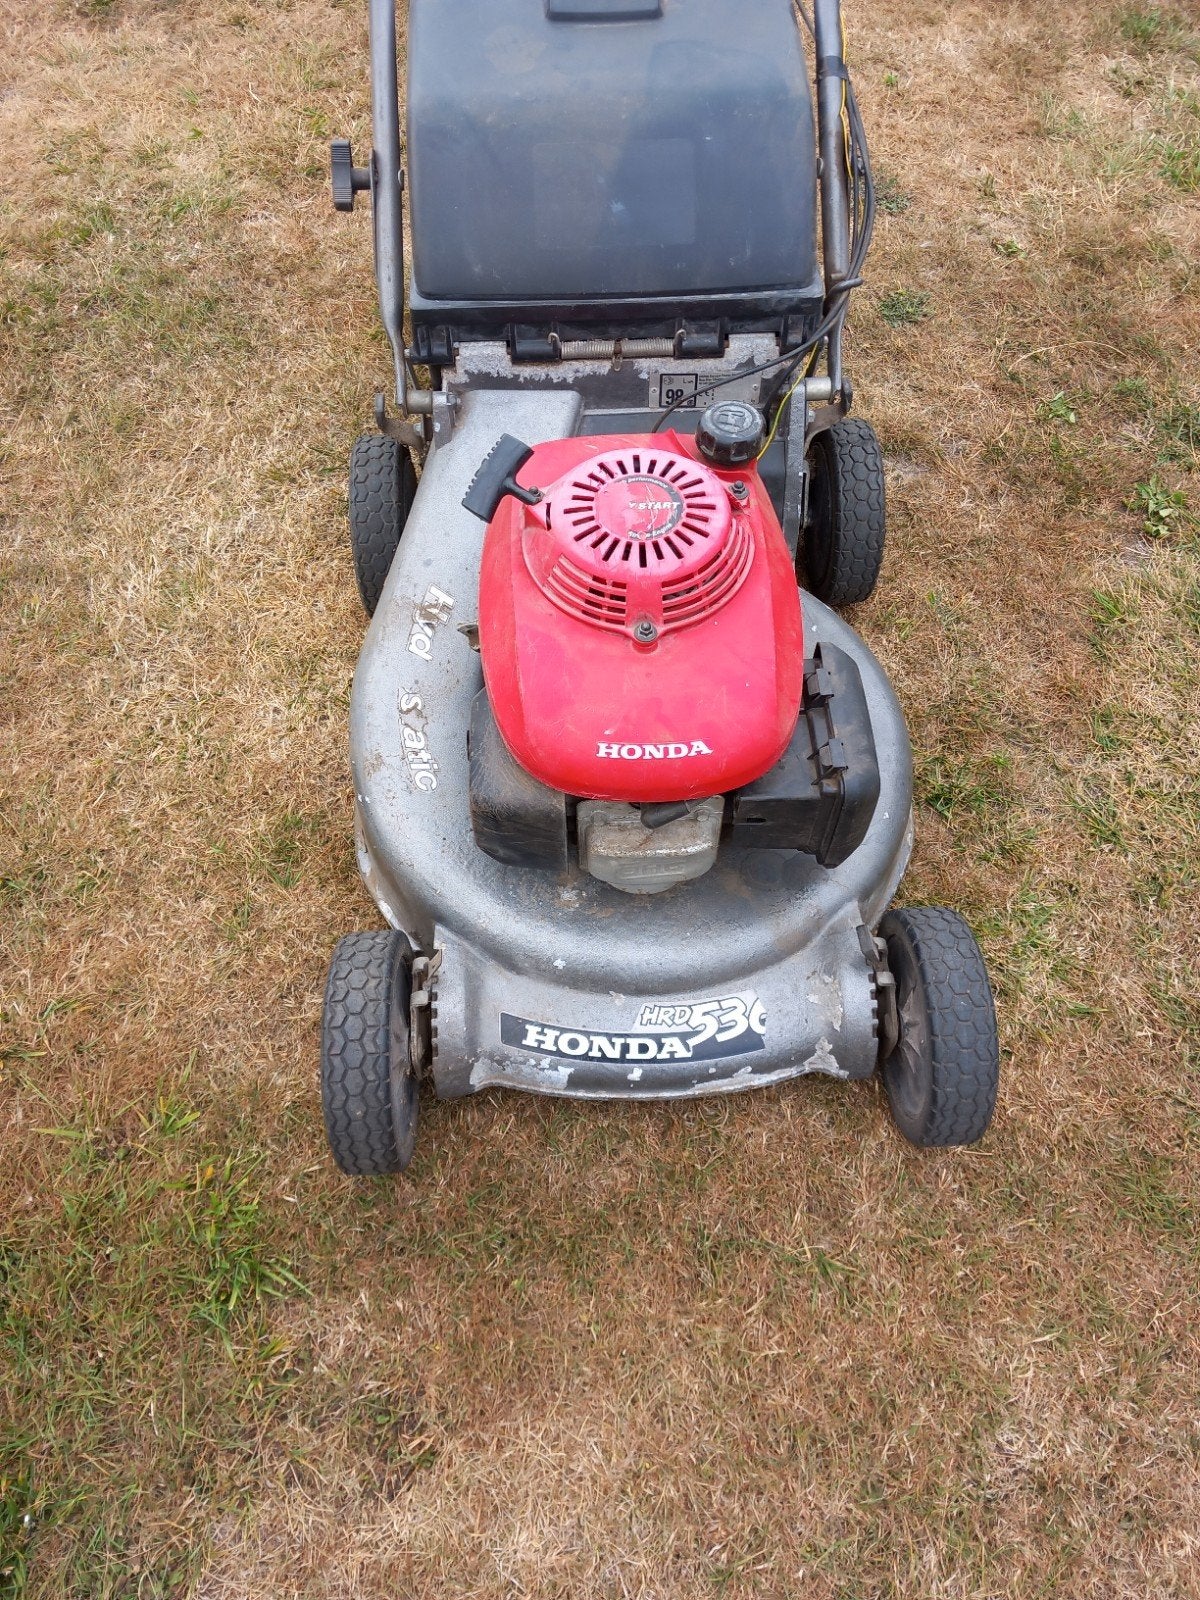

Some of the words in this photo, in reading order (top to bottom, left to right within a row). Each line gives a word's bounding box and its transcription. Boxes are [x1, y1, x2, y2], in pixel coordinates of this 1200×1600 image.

[596, 740, 714, 760] HONDA
[640, 1004, 692, 1027] HRD
[521, 1023, 693, 1060] HONDA
